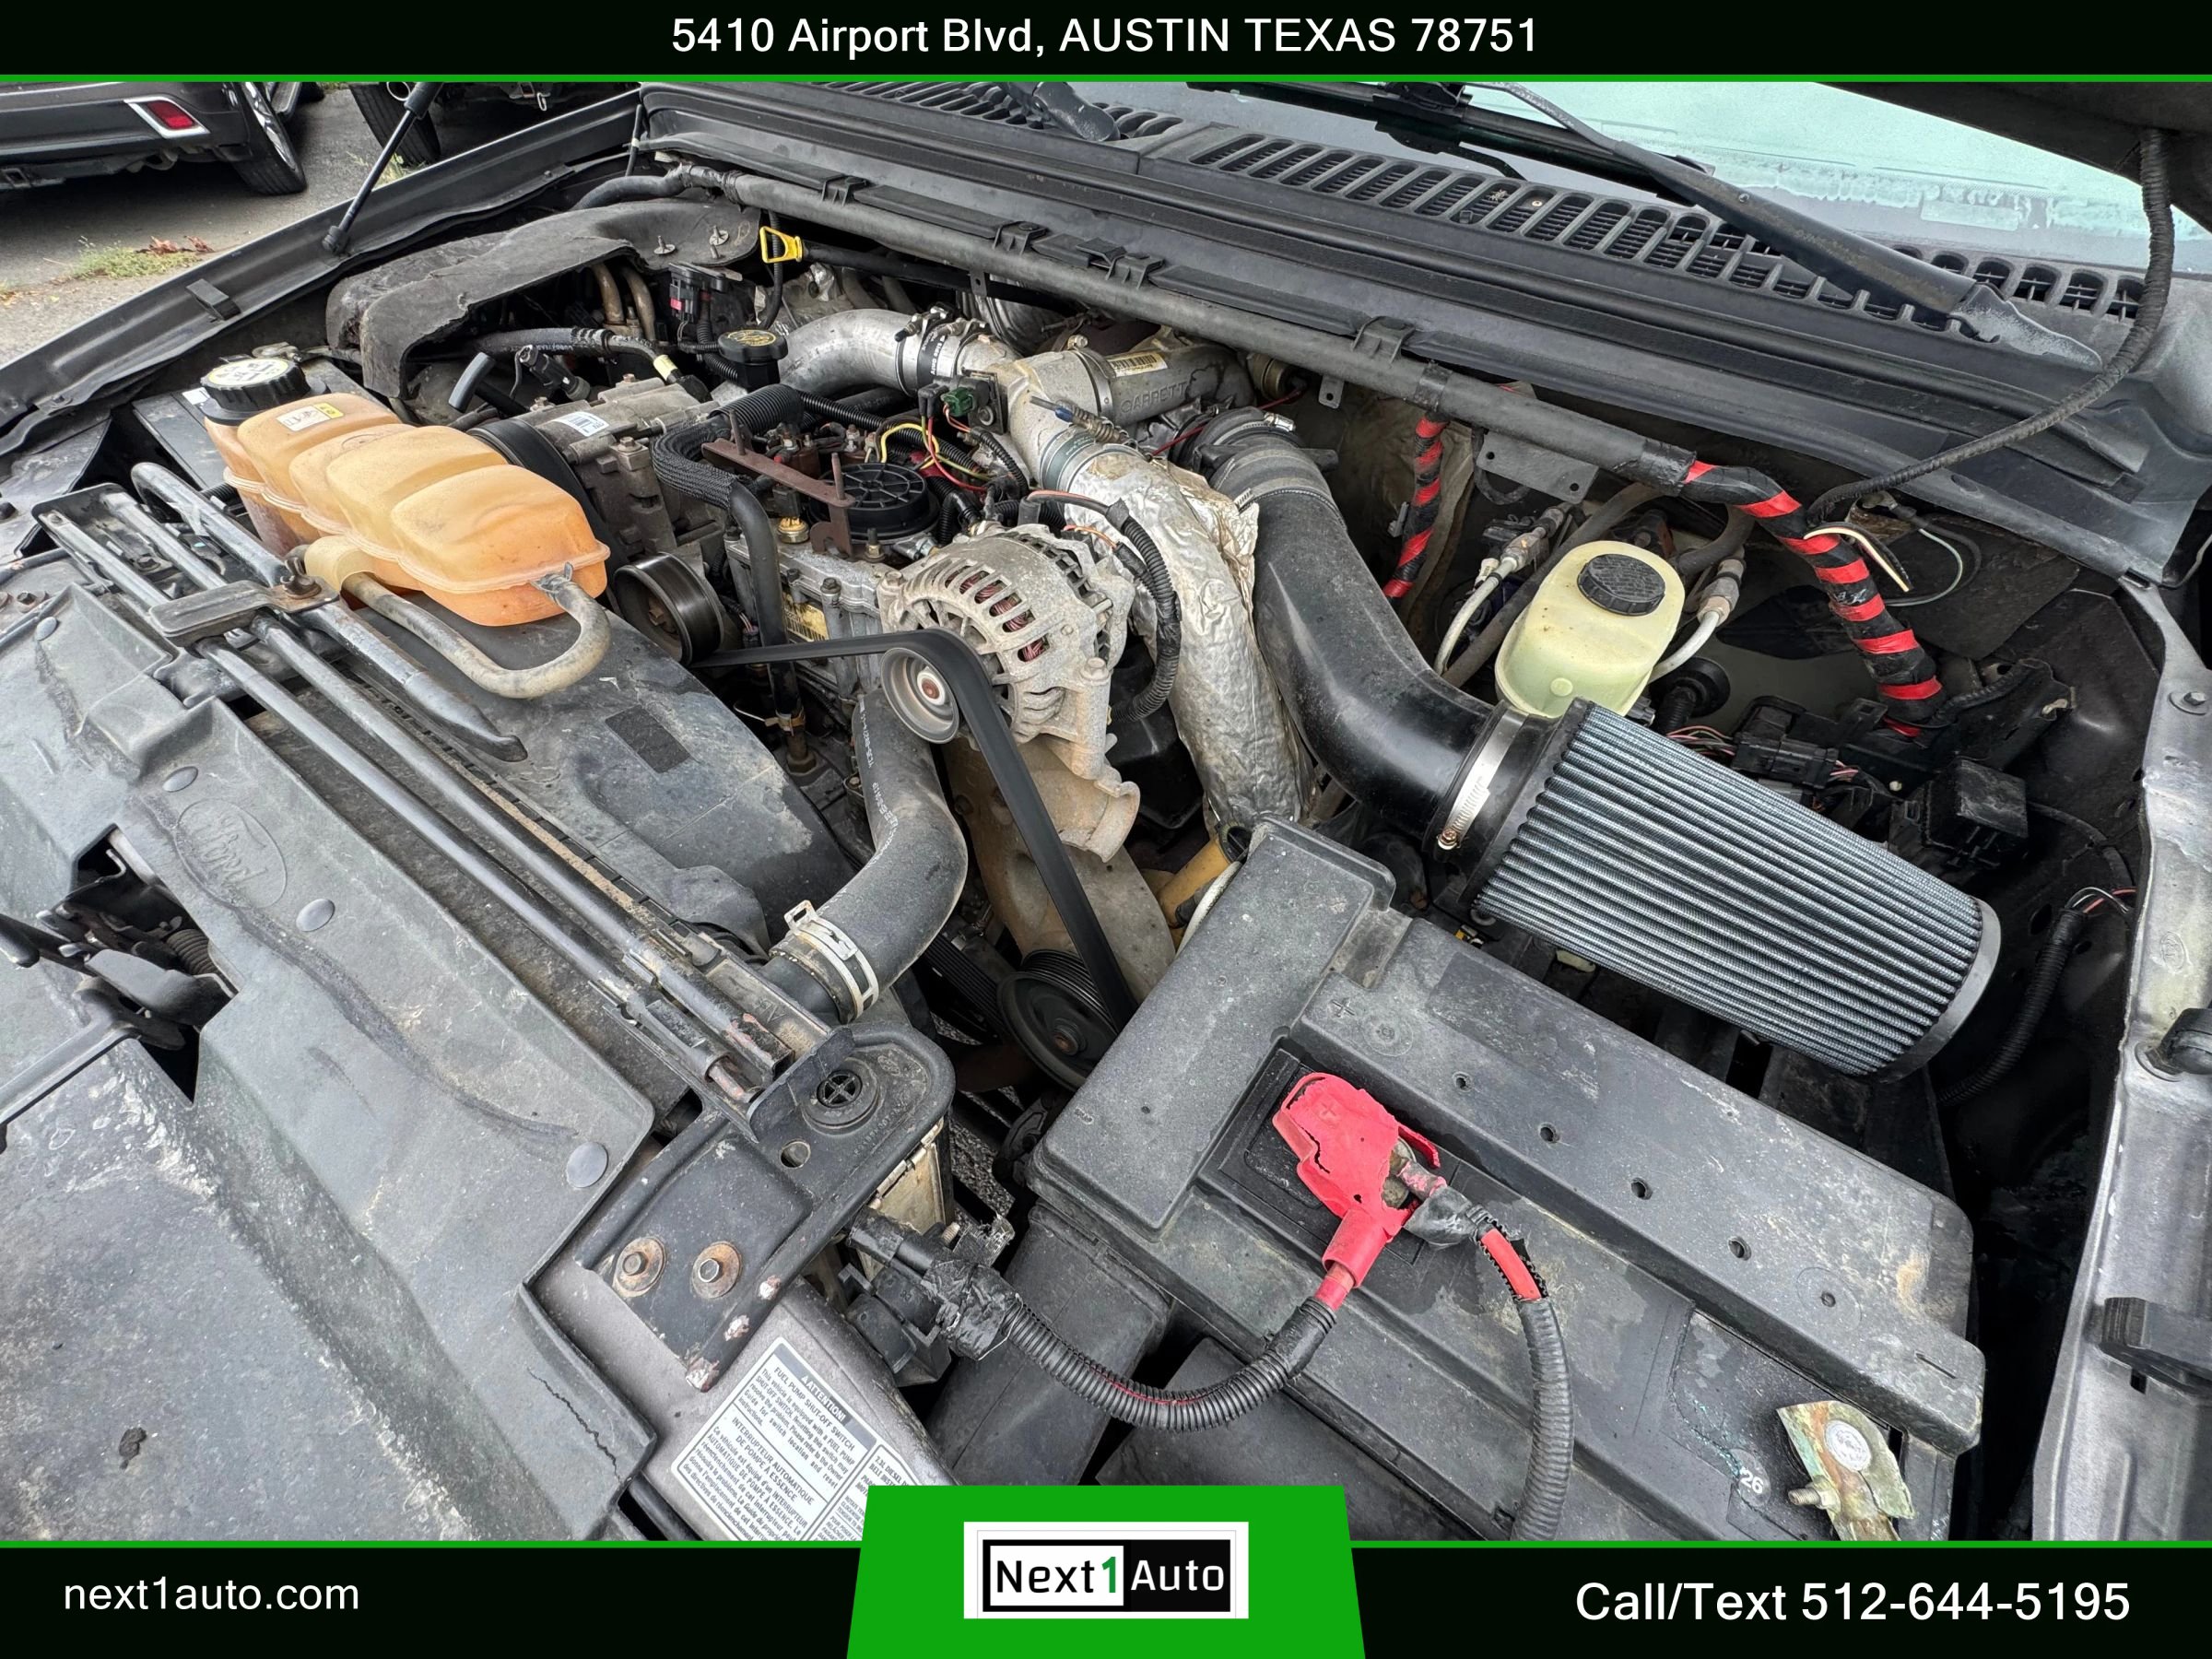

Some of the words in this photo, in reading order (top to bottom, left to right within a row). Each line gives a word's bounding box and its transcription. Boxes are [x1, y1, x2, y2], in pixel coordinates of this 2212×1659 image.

[1121, 381, 1188, 413] GARRETT
[749, 1382, 765, 1400] resolve
[764, 1398, 772, 1408] the
[789, 1424, 804, 1442] Please
[803, 1441, 815, 1453] refer
[814, 1451, 820, 1459] to
[819, 1455, 828, 1466] the
[827, 1464, 842, 1480] Owner
[755, 1375, 777, 1398] SHUT-OFF
[812, 1436, 822, 1448] this
[821, 1446, 838, 1464] switch
[837, 1462, 848, 1474] may
[761, 1368, 771, 1381] This
[771, 1380, 787, 1397] vehicle
[791, 1402, 814, 1425] equipped
[812, 1423, 823, 1435] with
[827, 1438, 840, 1453] FUEL
[839, 1450, 854, 1465] PUMP
[773, 1366, 788, 1384] FUEL
[787, 1382, 806, 1399] PUMP
[804, 1398, 832, 1427] SHUT-OFF
[830, 1426, 854, 1451] SWITCH
[806, 1380, 845, 1421] ATTENTION!
[707, 1433, 743, 1471] AUTOMATIQUE
[738, 1468, 747, 1479] DE
[746, 1477, 765, 1498] POMPE
[732, 1417, 773, 1464] INTERRUPTEUR
[771, 1461, 814, 1504] AUTOMATIQUE
[735, 1435, 746, 1446] DE
[744, 1444, 765, 1468] POMPE
[769, 1471, 797, 1501] ESSENCE
[744, 1389, 758, 1406] Guide
[759, 1406, 768, 1417] for
[769, 1418, 786, 1437] switch
[787, 1436, 808, 1460] location
[810, 1461, 822, 1473] and
[822, 1473, 838, 1488] reset
[683, 1464, 691, 1474] des
[710, 1495, 717, 1503] de
[688, 1455, 703, 1473] donne
[734, 1507, 741, 1515] de
[740, 1514, 750, 1524] cet
[737, 1454, 747, 1465] est
[771, 1490, 807, 1528] INTERRUPTEUR
[737, 1483, 746, 1492] de
[745, 1491, 755, 1501] cet
[884, 1465, 901, 1483] DIESEL
